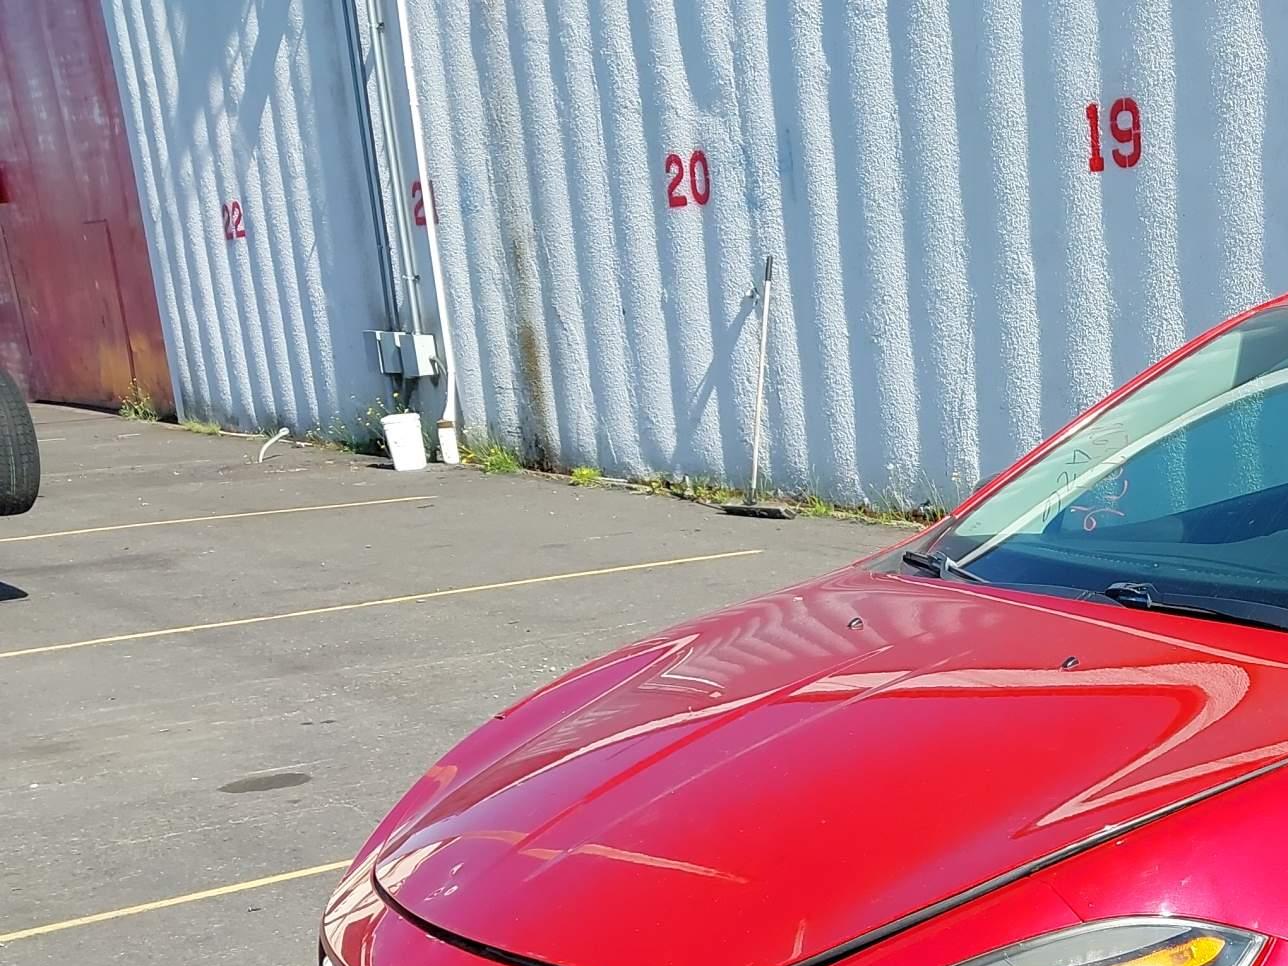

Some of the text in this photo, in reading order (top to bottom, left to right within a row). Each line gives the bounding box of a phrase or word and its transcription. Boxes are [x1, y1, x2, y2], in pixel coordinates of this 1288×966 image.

[1086, 98, 1141, 172] 19
[665, 150, 710, 208] 20
[222, 201, 246, 240] 22
